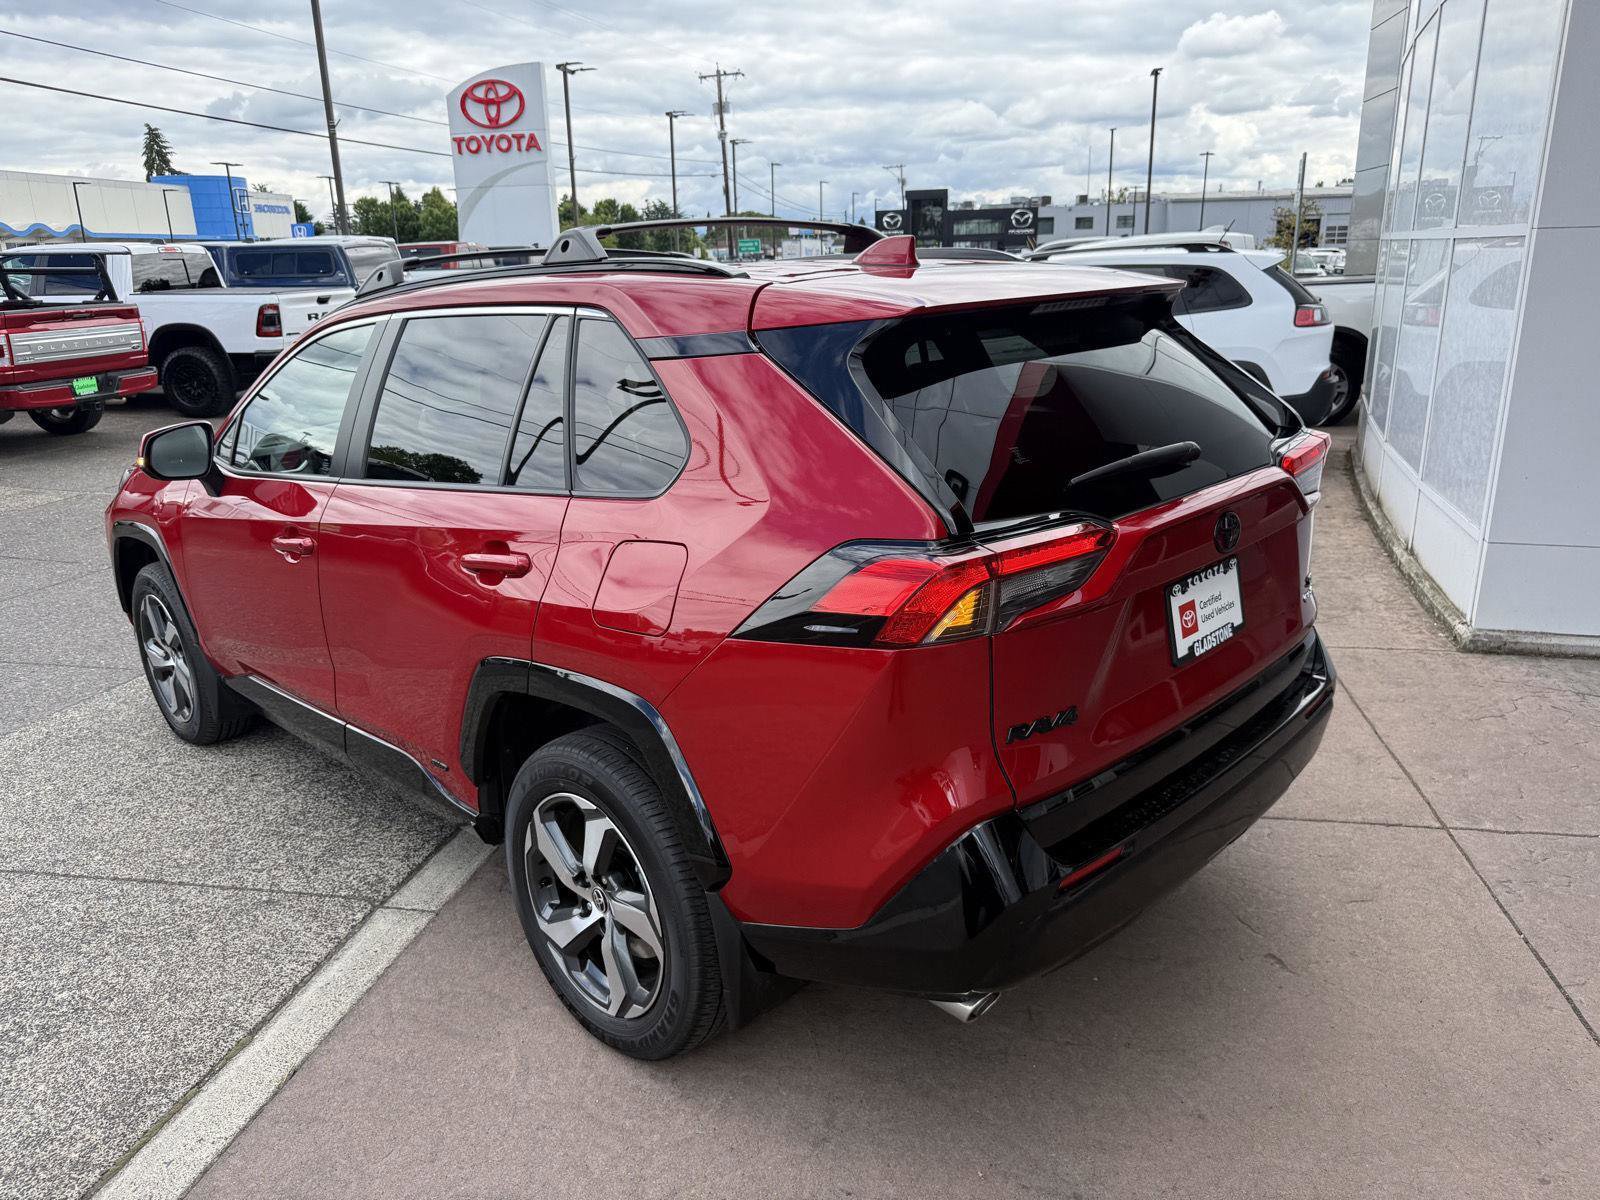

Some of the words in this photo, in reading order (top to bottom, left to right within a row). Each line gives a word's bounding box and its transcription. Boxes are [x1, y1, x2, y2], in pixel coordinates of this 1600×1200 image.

[452, 133, 542, 155] TOYOTA
[37, 337, 125, 351] PLATINUM
[1186, 564, 1225, 588] TOYOTA
[1199, 592, 1222, 610] Certified
[1200, 609, 1215, 623] Used
[1214, 600, 1235, 617] Vehicles
[1193, 623, 1234, 657] GLADSTONE
[1006, 705, 1078, 744] RAV4
